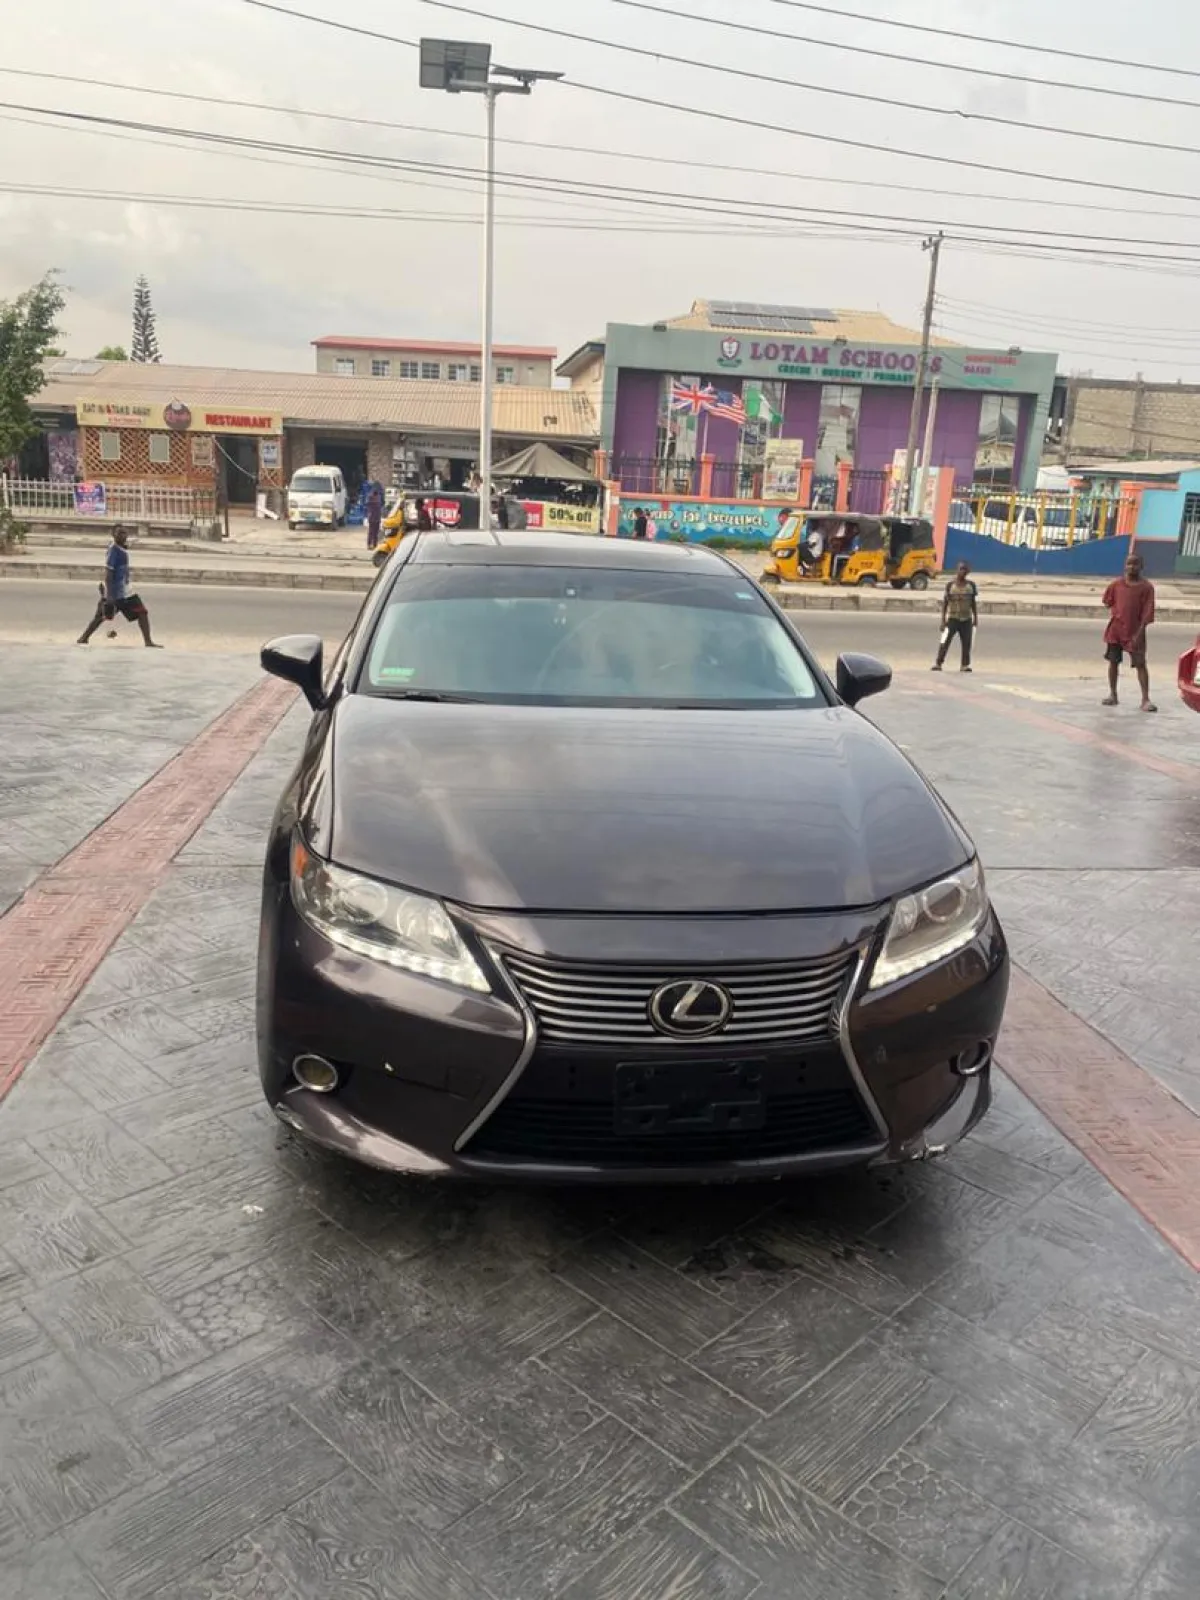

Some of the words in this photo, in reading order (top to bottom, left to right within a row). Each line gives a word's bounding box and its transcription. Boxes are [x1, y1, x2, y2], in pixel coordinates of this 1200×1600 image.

[749, 342, 830, 365] LOTAM
[839, 350, 943, 373] SCHOOS
[205, 413, 273, 429] RESTAURANT
[549, 507, 574, 521] 50%
